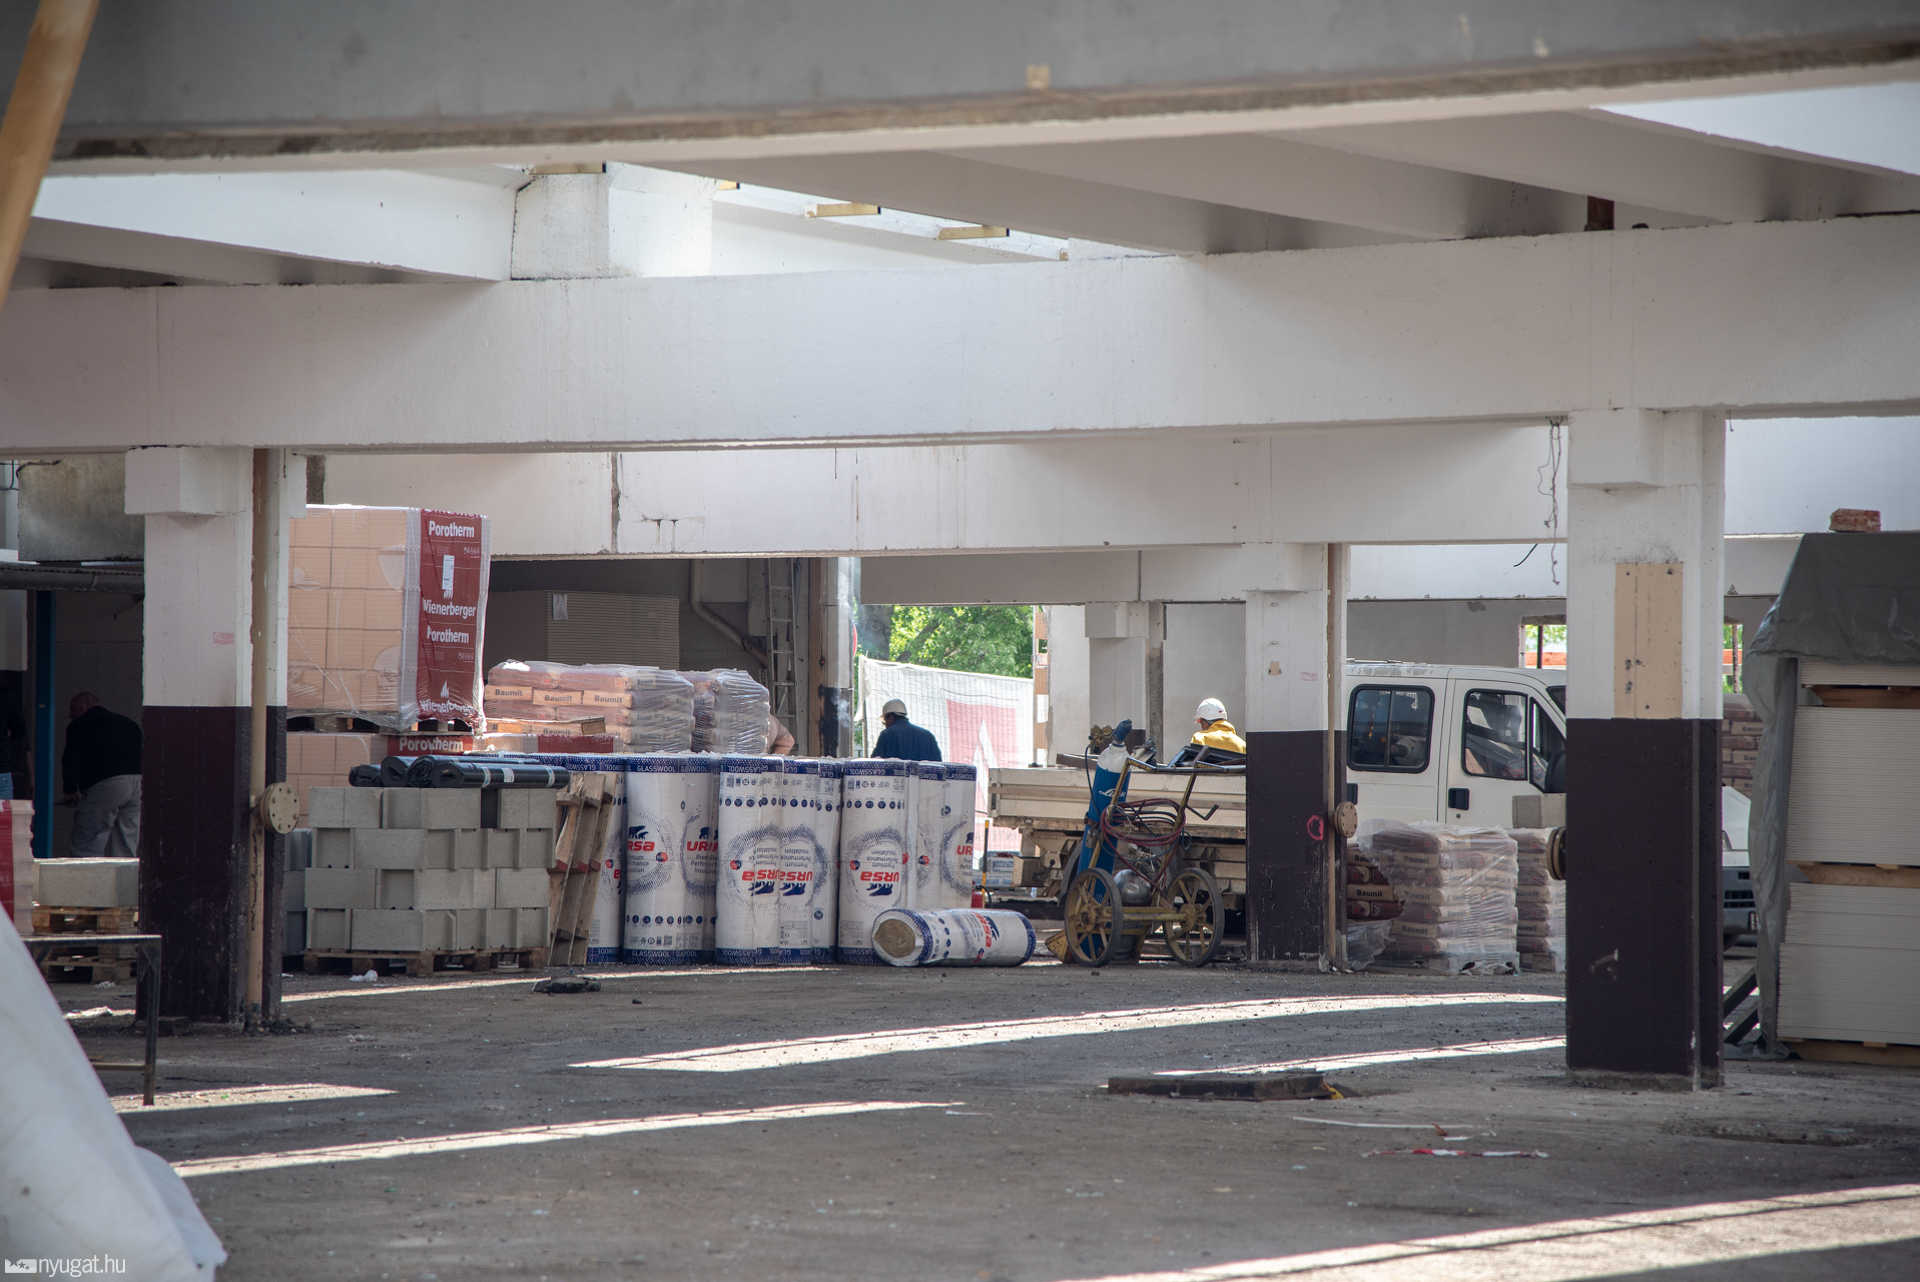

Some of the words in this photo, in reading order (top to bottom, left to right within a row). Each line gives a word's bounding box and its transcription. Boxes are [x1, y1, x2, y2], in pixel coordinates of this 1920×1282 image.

[428, 520, 475, 538] Porotherm
[422, 600, 476, 619] Wienerberger
[400, 738, 464, 752] Porotherm
